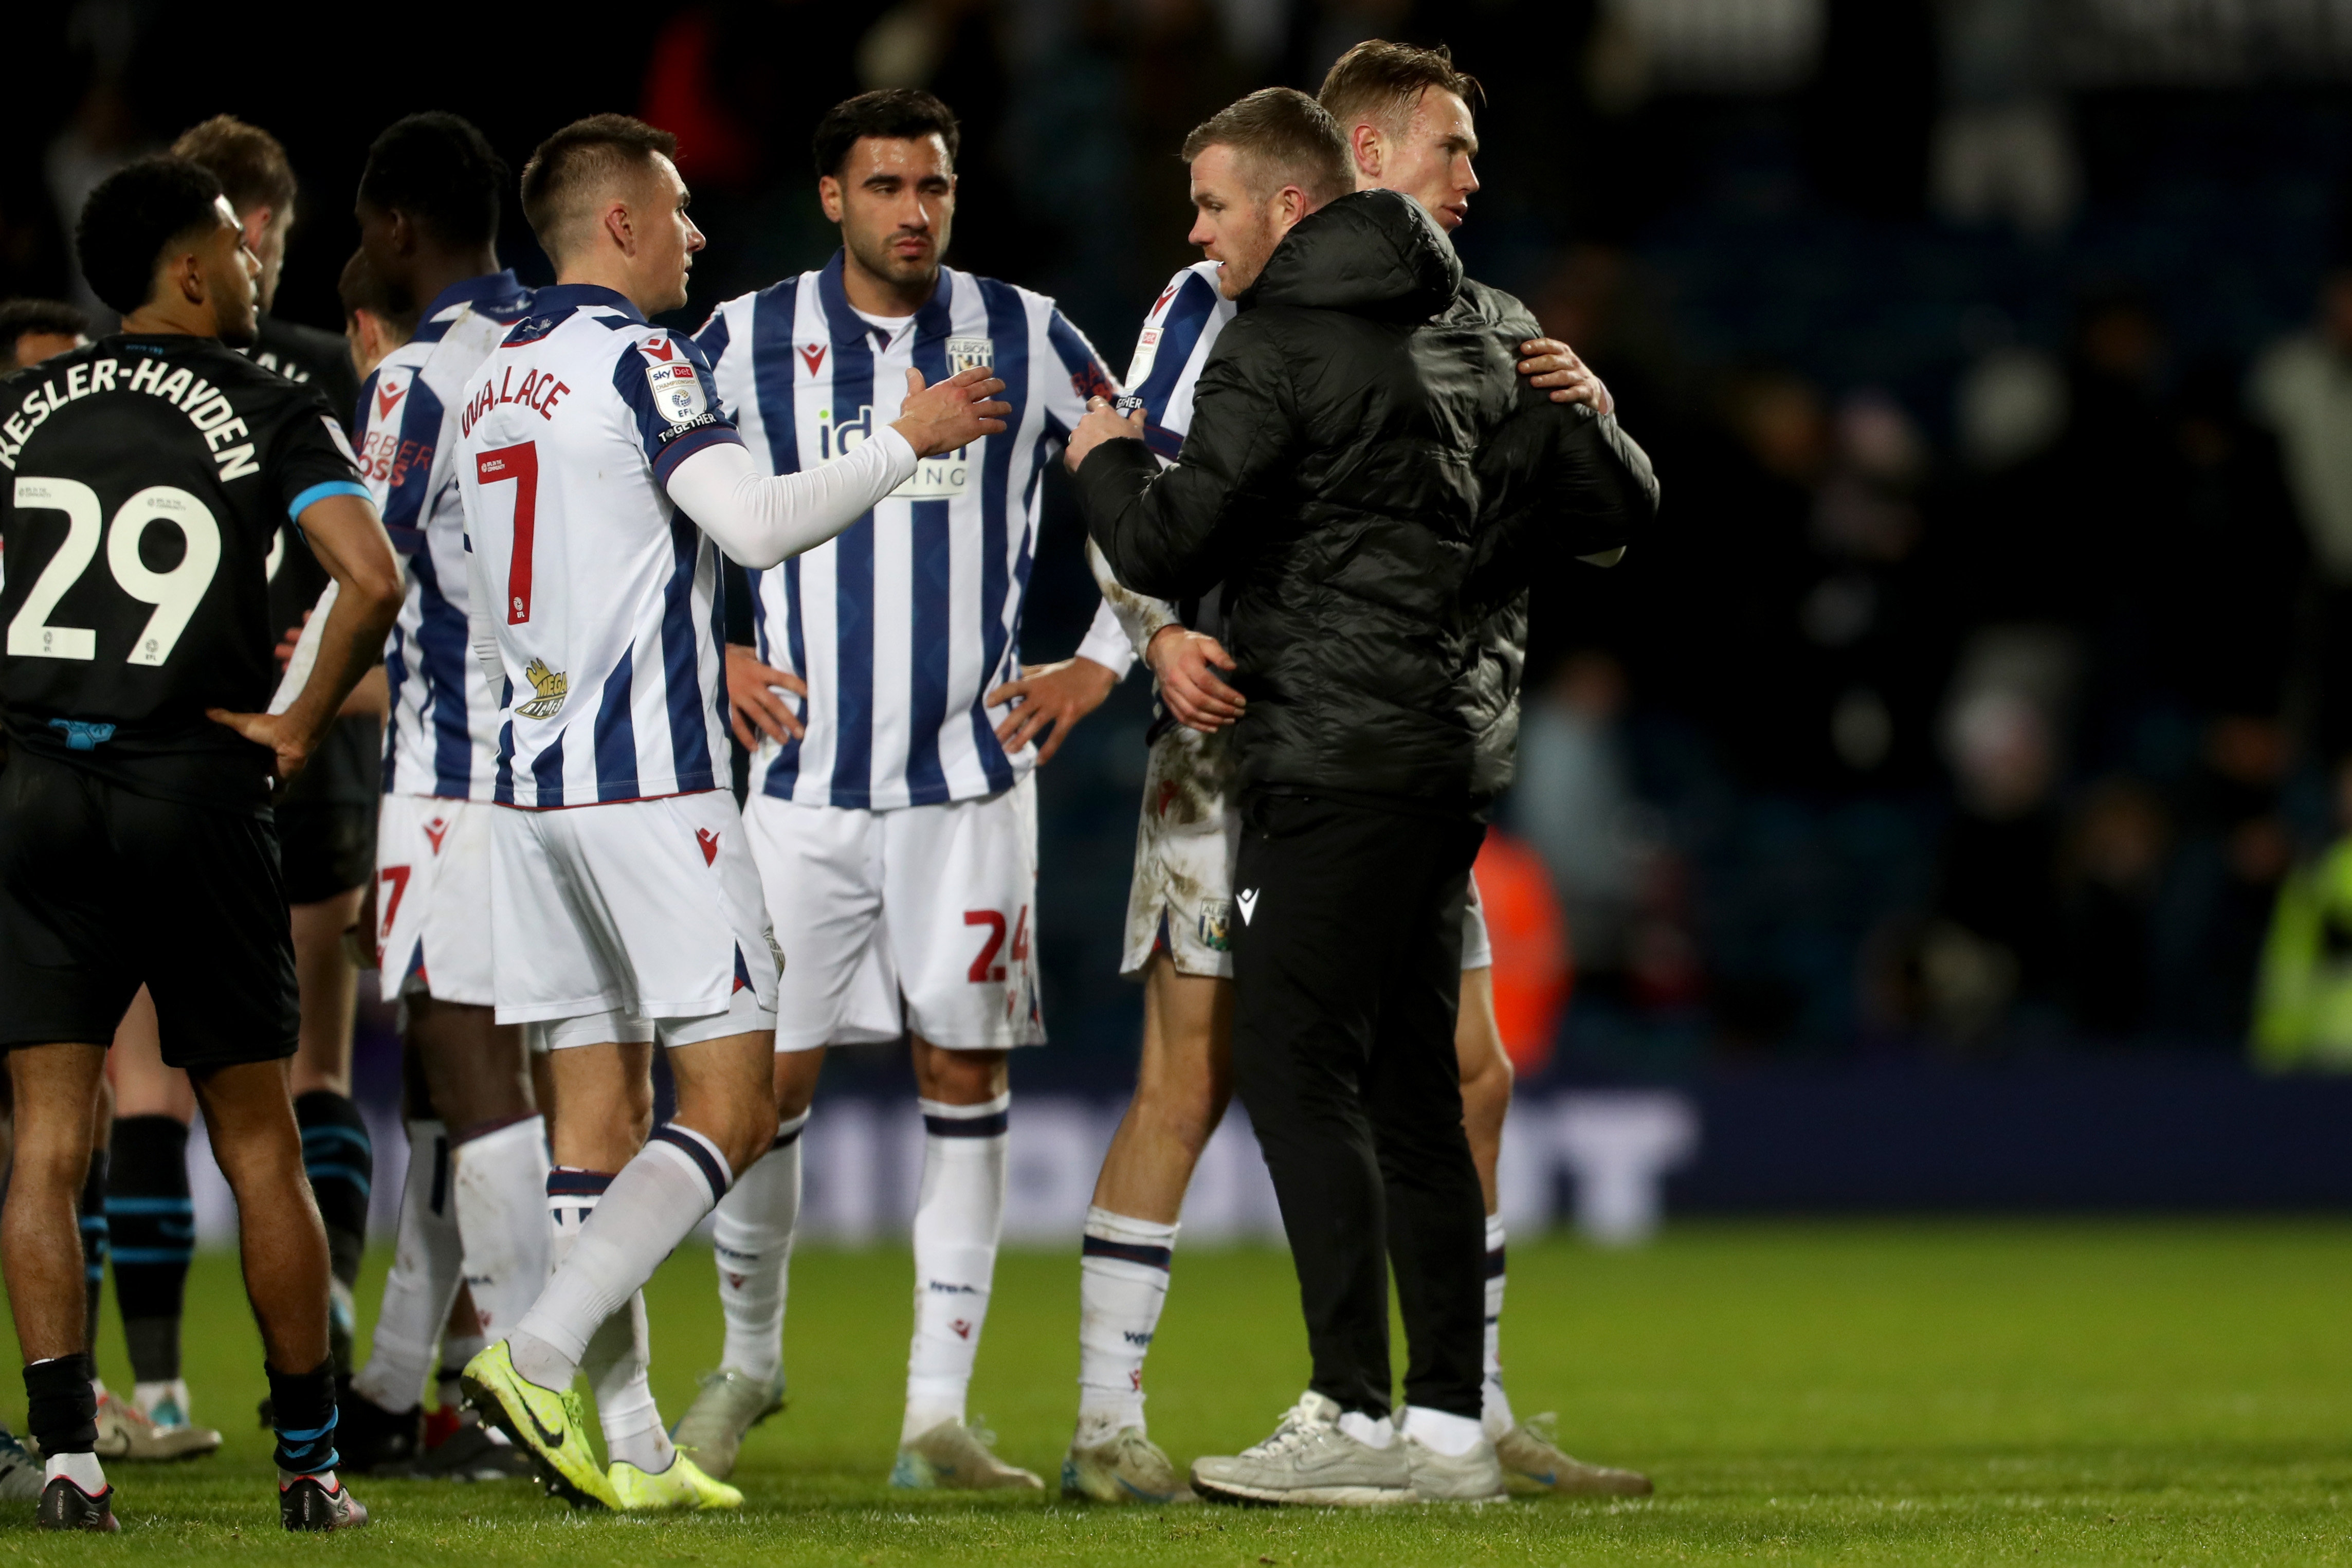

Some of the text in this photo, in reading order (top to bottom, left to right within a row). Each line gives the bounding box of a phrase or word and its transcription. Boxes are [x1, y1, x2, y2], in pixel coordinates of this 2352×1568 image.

[462, 366, 571, 440] WALACE
[652, 368, 691, 381] sky bet
[656, 379, 696, 391] CHAMPIONSHIP
[476, 440, 538, 626] 7
[7, 476, 222, 666] 29
[536, 671, 568, 698] MEGA
[964, 903, 1028, 984] 24
